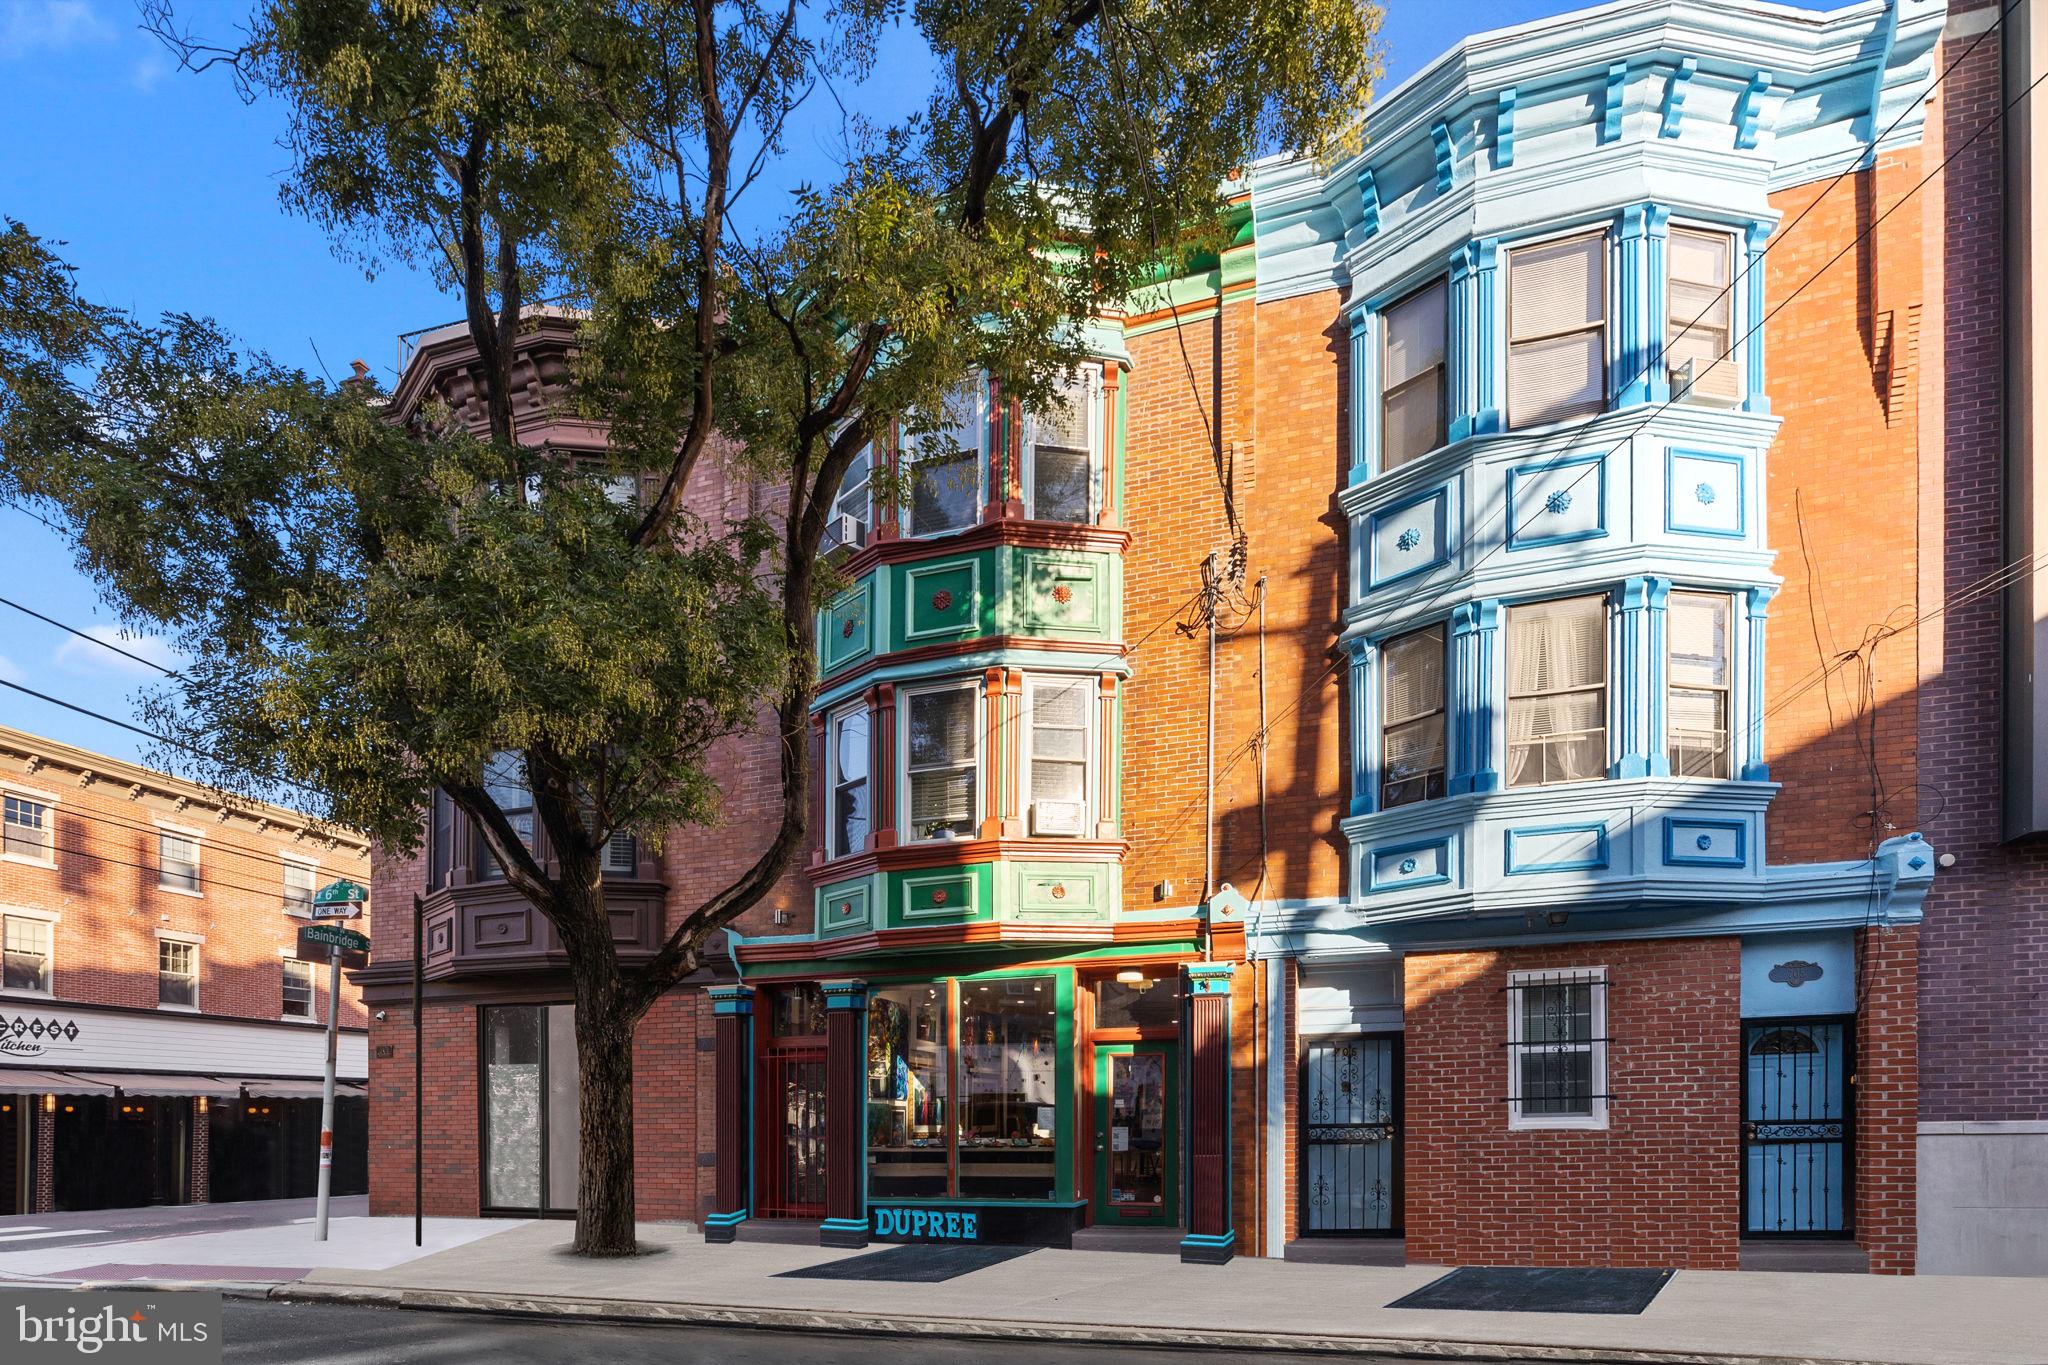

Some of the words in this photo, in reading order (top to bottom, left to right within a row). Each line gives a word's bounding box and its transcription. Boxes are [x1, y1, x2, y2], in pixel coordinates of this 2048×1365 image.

[325, 889, 339, 900] 6th
[347, 889, 360, 899] St
[317, 907, 331, 915] ONE
[333, 907, 347, 915] WAY
[307, 927, 359, 949] Bainbridge
[875, 1208, 977, 1239] DUPREE
